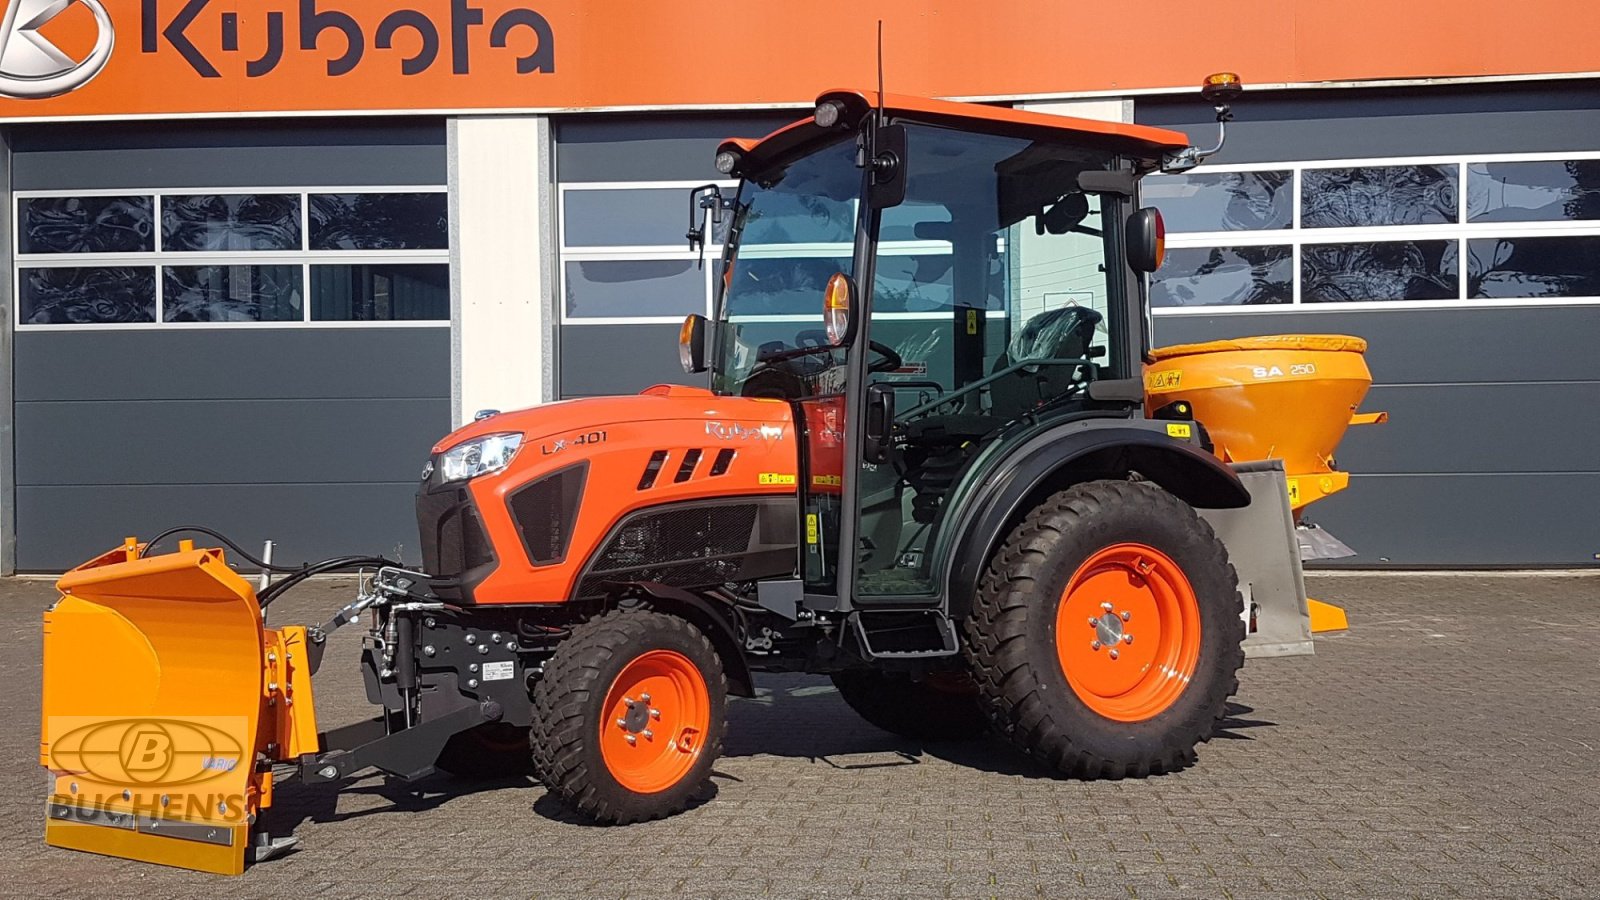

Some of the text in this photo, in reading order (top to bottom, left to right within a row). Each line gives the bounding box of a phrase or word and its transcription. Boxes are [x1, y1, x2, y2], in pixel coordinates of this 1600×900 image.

[141, 0, 556, 78] Kubota
[1253, 363, 1316, 378] SA 250
